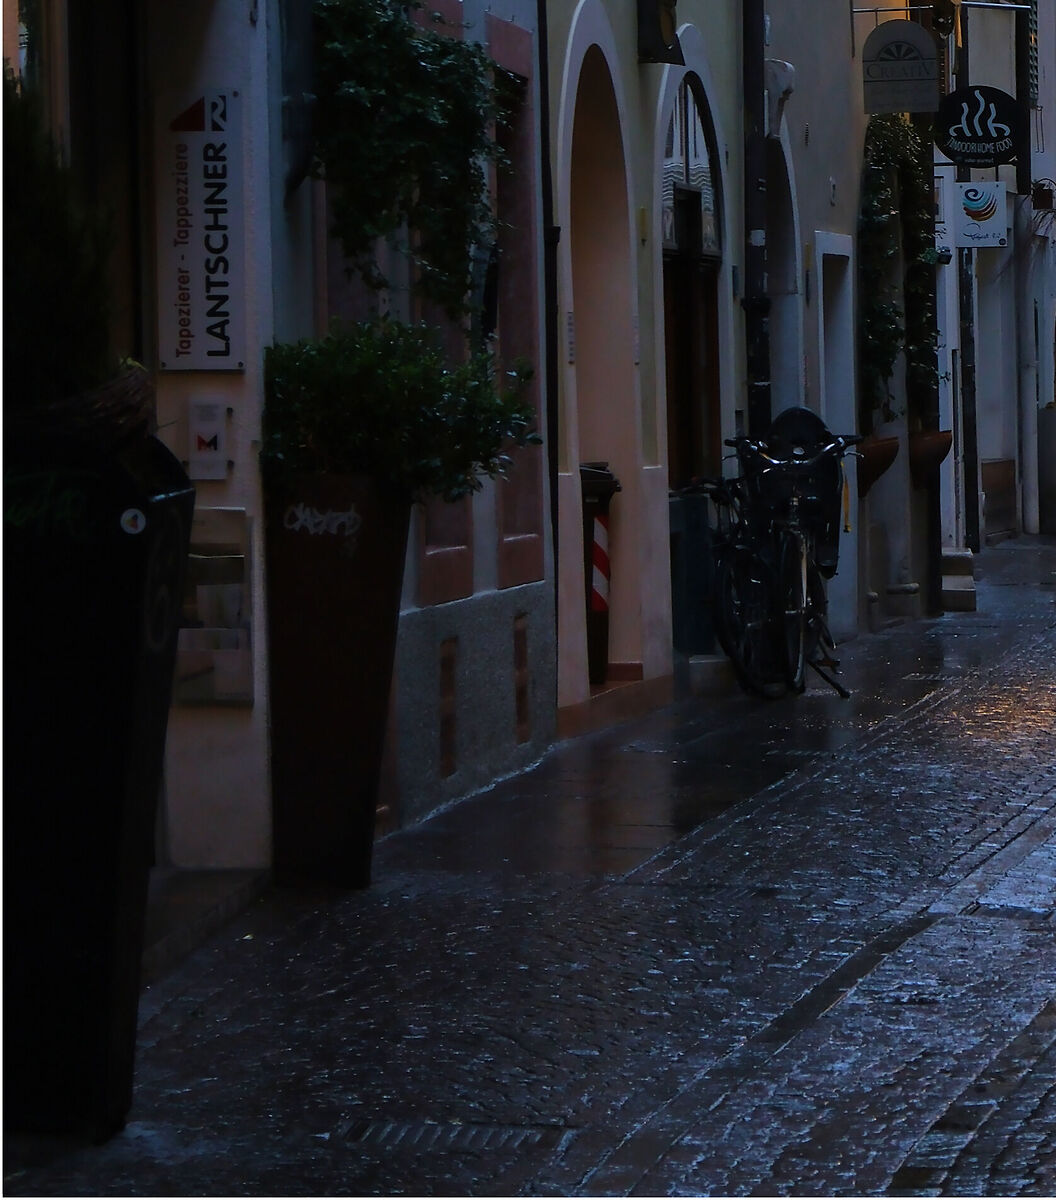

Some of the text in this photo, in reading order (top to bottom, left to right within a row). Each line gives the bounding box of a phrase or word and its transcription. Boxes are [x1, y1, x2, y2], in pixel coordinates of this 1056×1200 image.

[173, 143, 194, 248] Tappezziere
[203, 142, 230, 357] LANTSCHNER
[176, 268, 194, 358] Tapezierer
